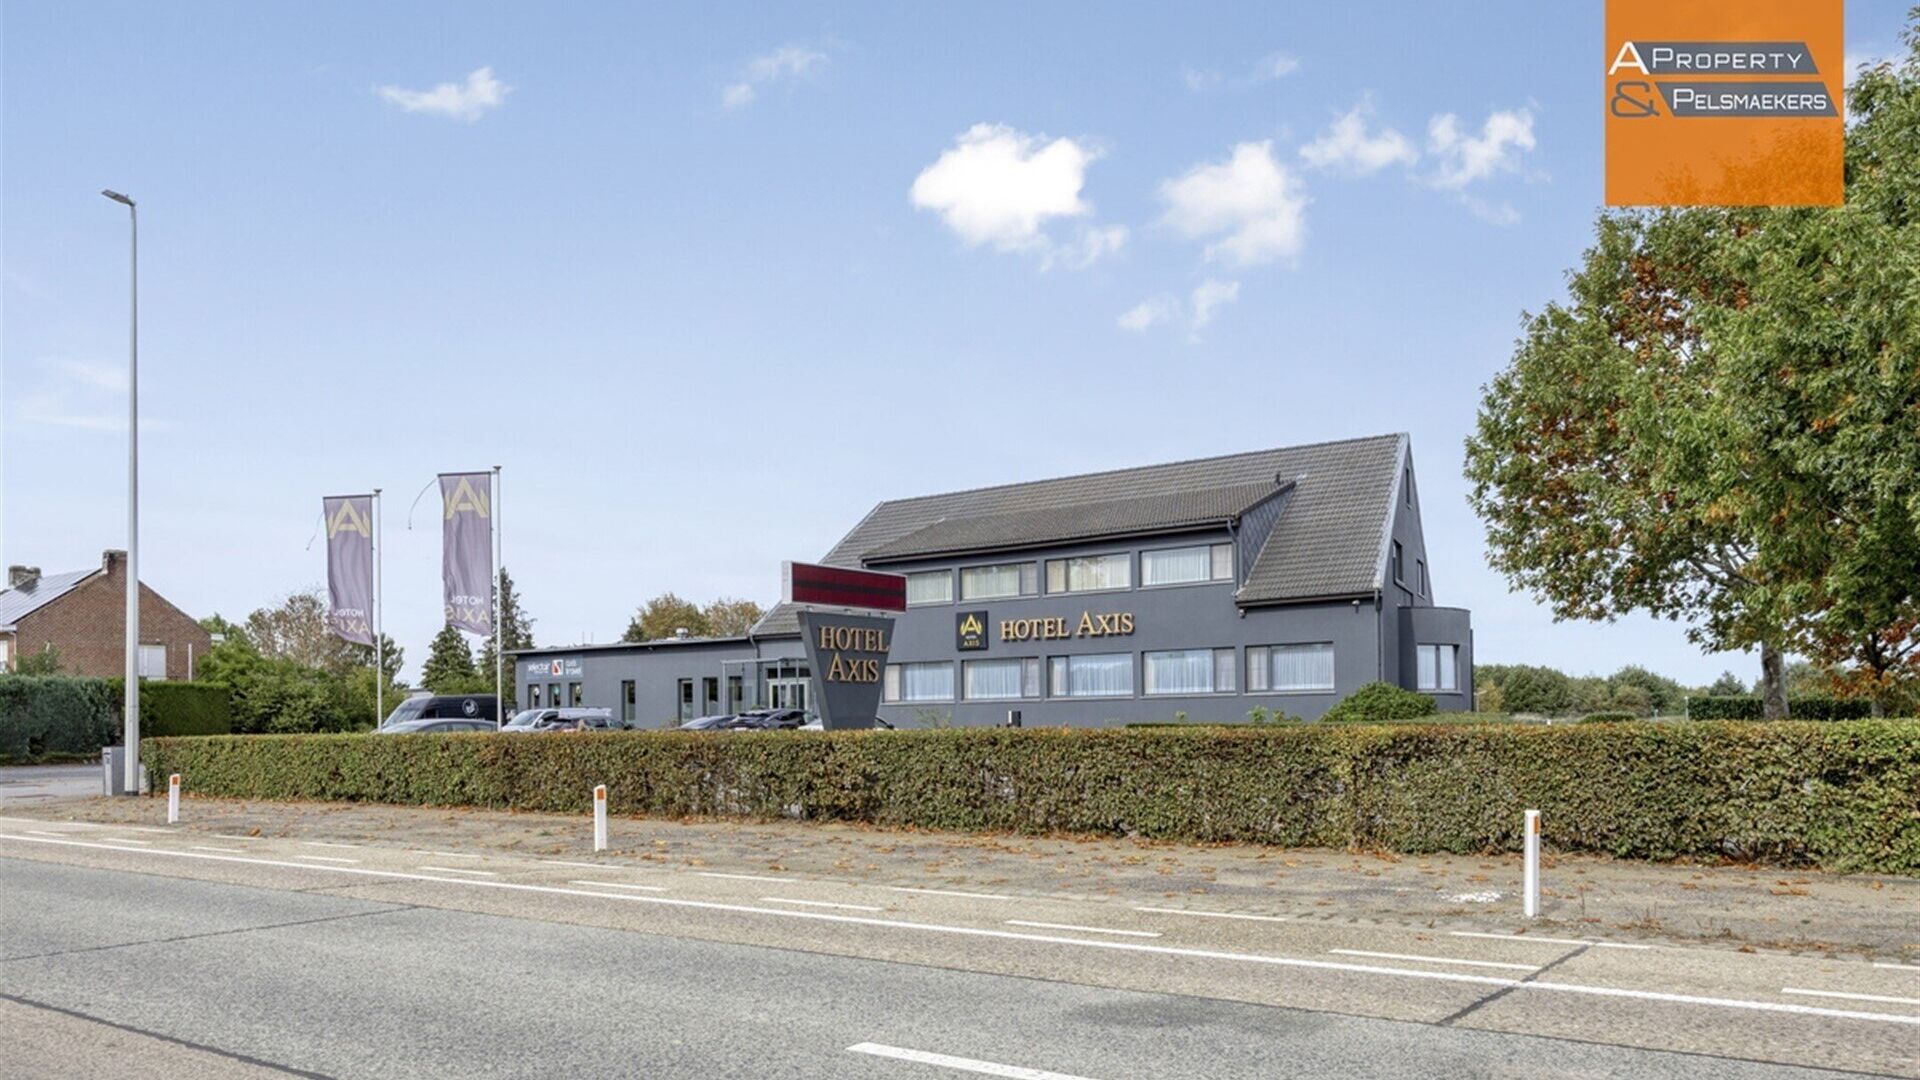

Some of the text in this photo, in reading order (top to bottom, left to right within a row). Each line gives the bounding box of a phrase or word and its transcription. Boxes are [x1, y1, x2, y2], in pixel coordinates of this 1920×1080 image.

[819, 625, 890, 653] HOTEL
[1000, 610, 1135, 640] HOTEL AXIS
[827, 652, 880, 682] AXIS
